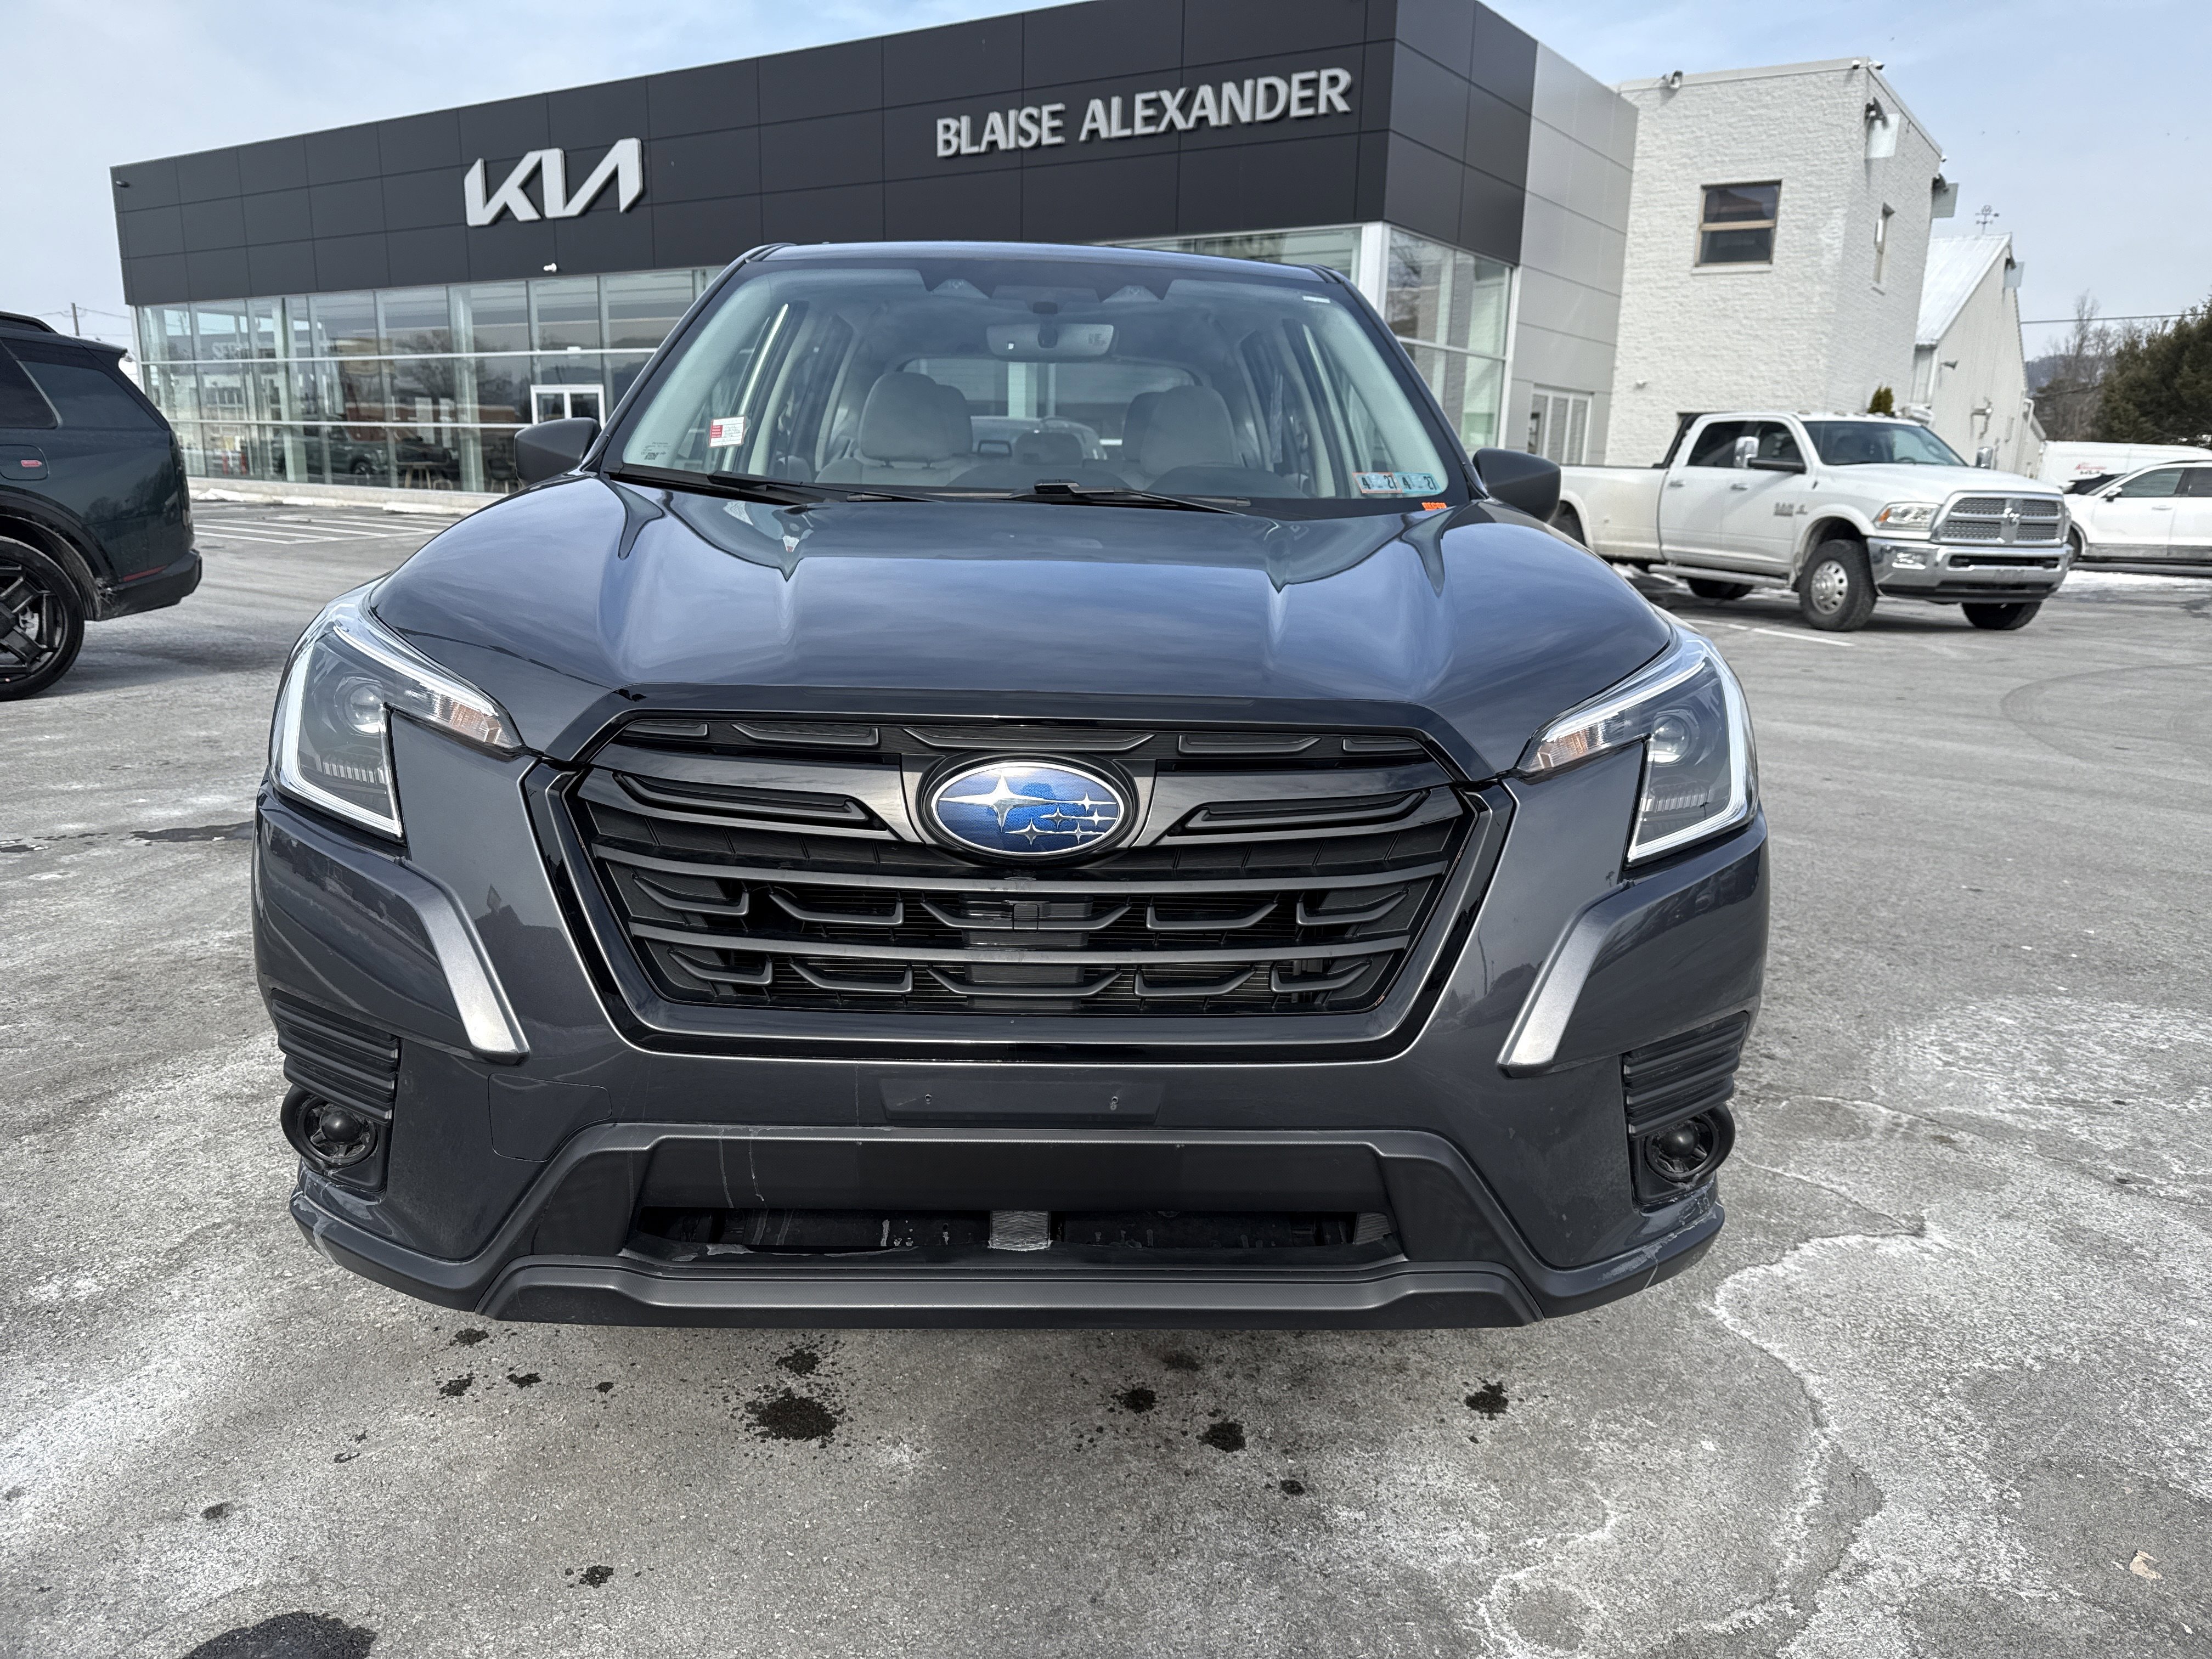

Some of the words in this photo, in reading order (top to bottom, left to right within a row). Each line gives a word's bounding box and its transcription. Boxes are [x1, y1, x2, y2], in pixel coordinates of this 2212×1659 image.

[936, 103, 1066, 157] BLAISE
[1079, 67, 1353, 141] ALEXANDER
[464, 137, 644, 227] KIA
[1361, 477, 1371, 490] 4
[1402, 477, 1412, 490] 4
